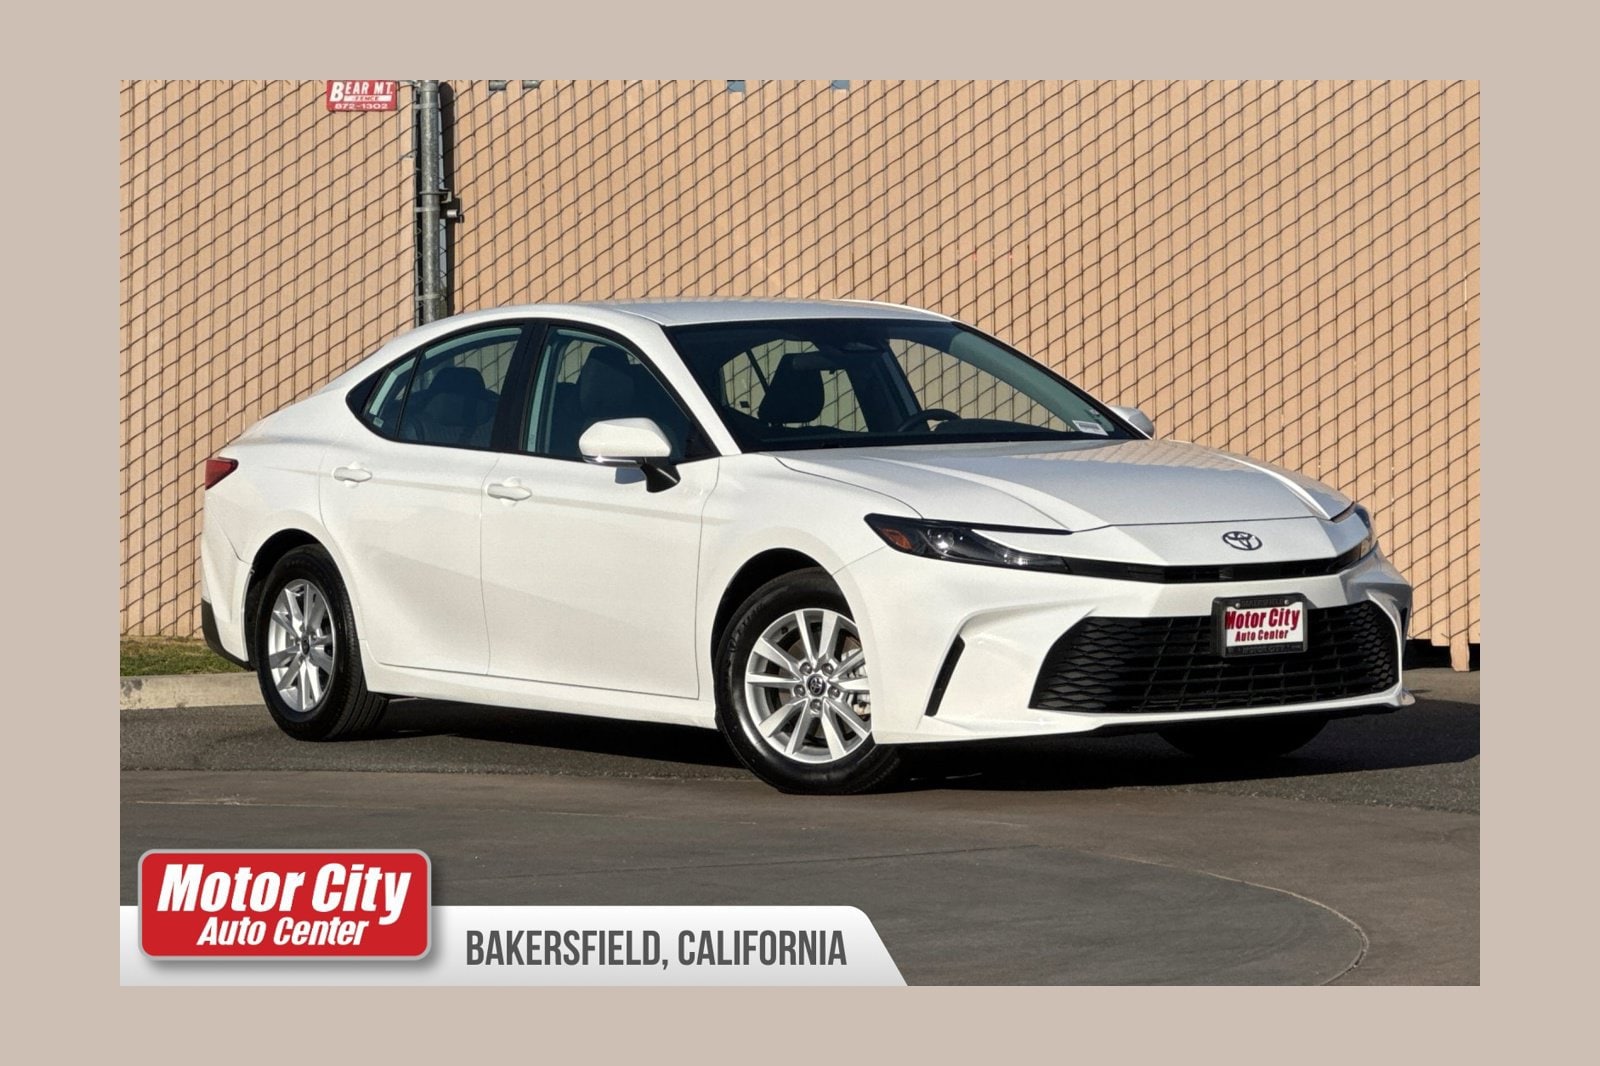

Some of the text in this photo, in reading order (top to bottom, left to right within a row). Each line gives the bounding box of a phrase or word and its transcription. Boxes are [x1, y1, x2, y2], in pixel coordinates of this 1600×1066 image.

[330, 81, 394, 102] BEAR MT.
[1225, 608, 1300, 631] Motor City
[1234, 629, 1289, 642] Auto Center
